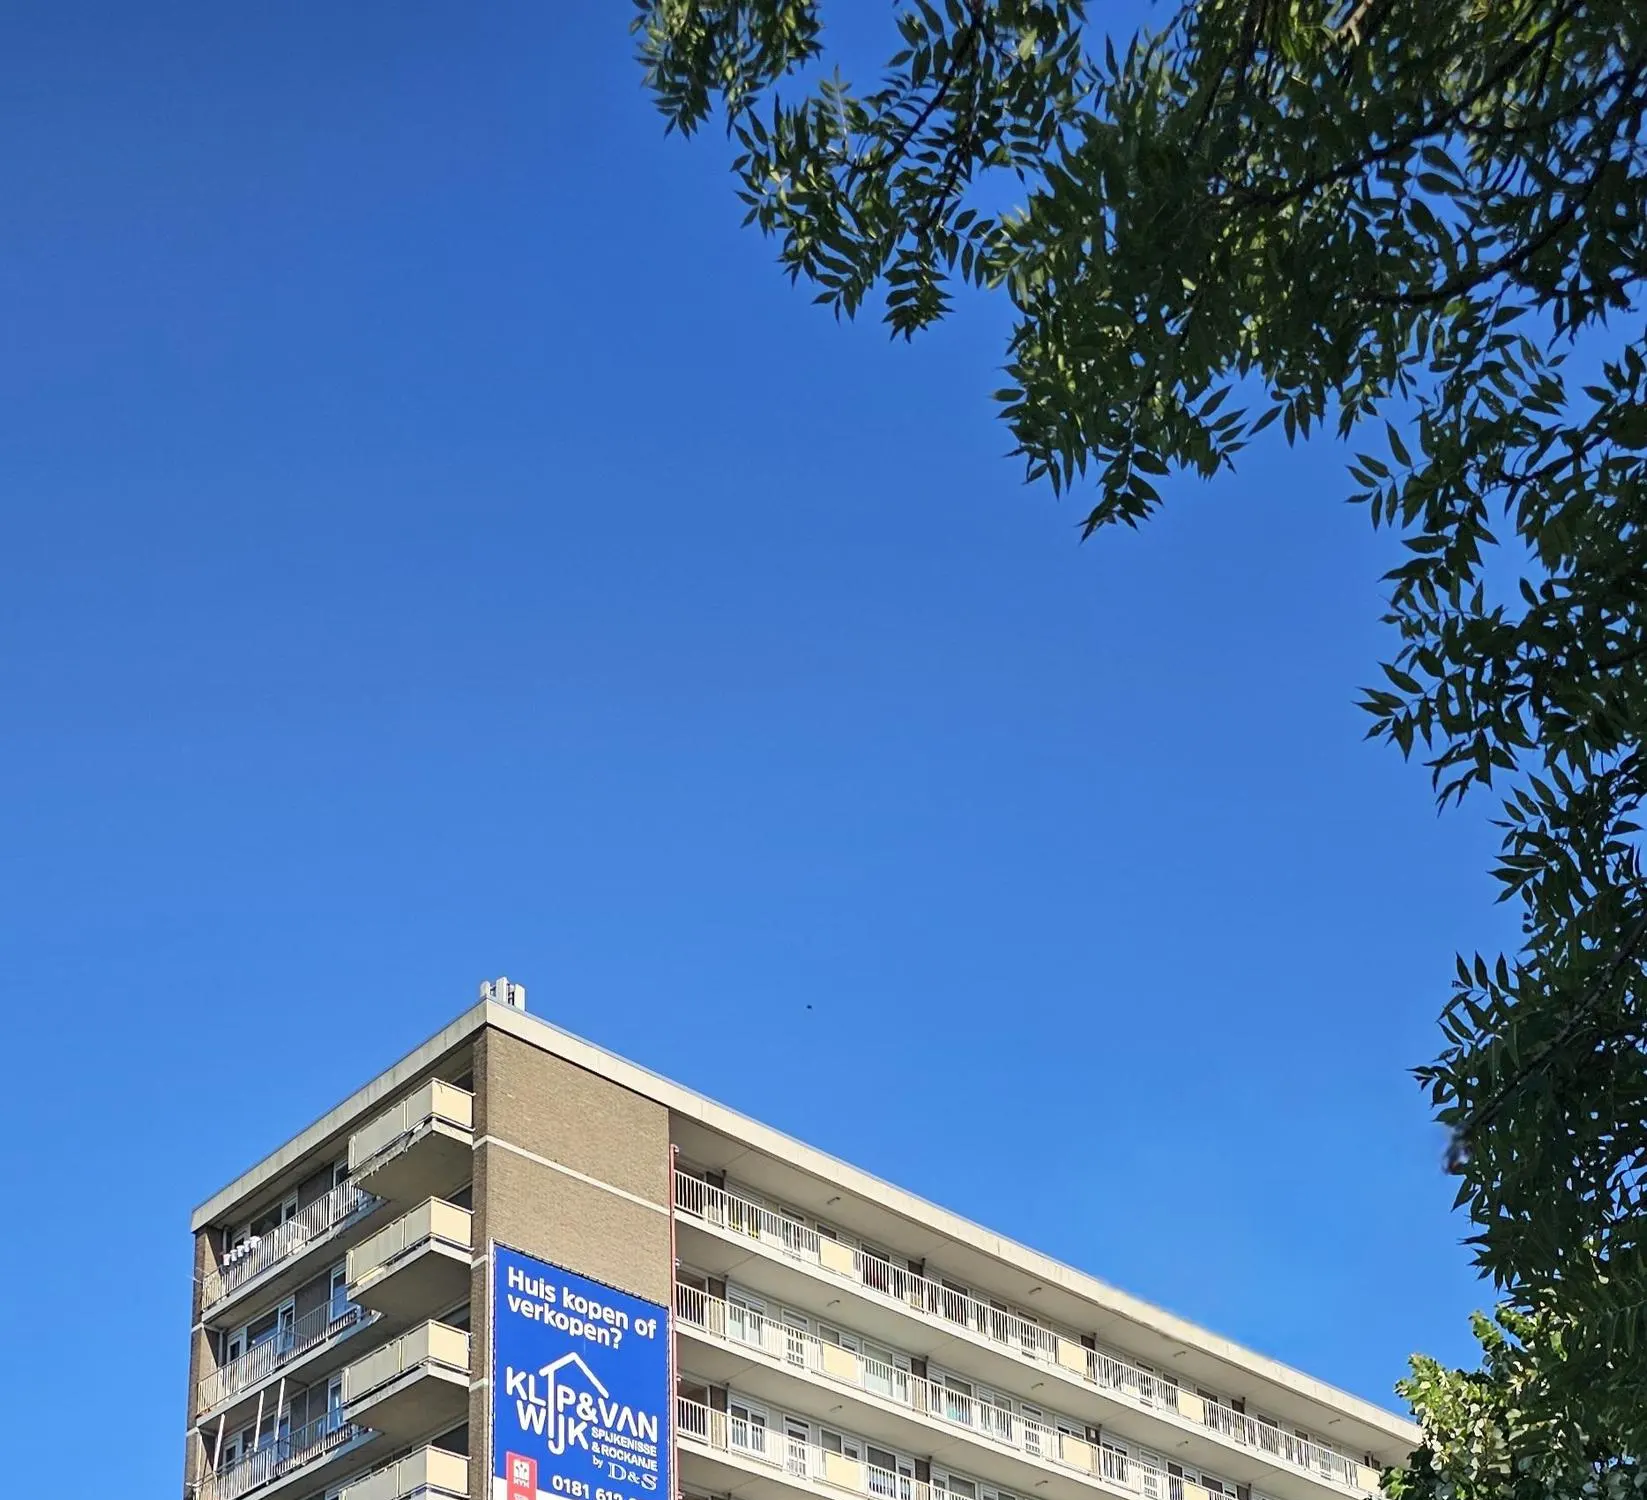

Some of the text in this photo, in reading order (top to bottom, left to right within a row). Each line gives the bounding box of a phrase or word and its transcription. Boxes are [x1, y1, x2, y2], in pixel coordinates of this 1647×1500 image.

[508, 1266, 657, 1339] Huis kopen of
[507, 1294, 623, 1349] verkopen?
[591, 1426, 657, 1457] SPIJKENISSE
[592, 1455, 604, 1469] by
[552, 1474, 590, 1500] 0181
